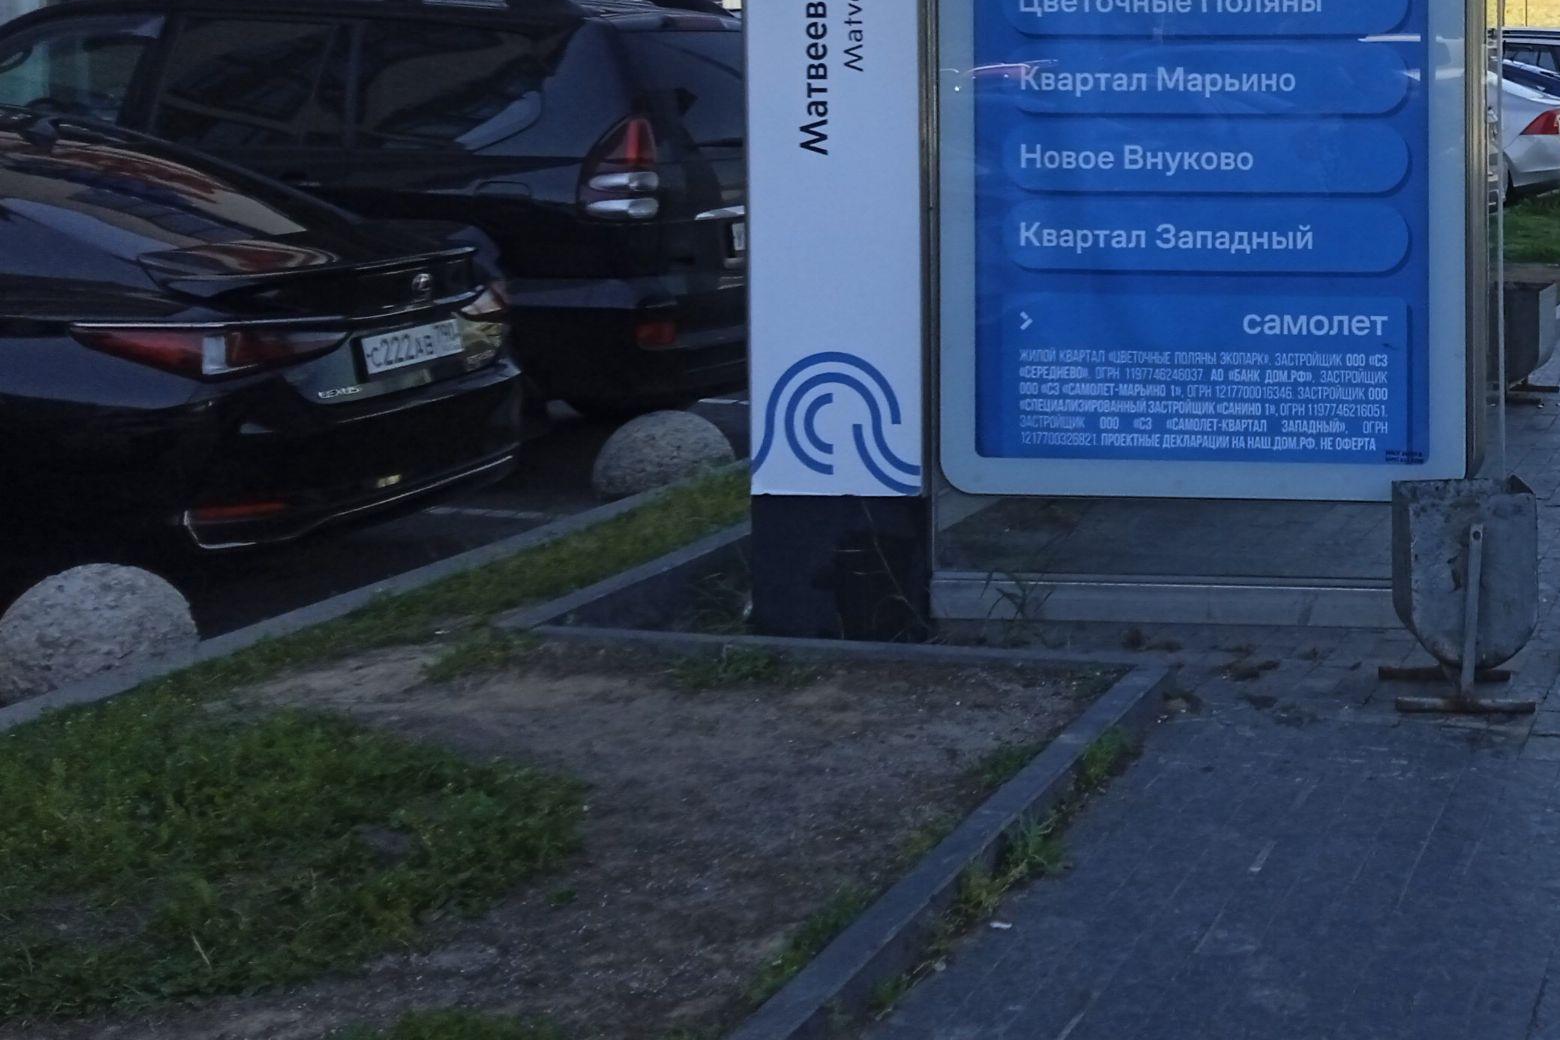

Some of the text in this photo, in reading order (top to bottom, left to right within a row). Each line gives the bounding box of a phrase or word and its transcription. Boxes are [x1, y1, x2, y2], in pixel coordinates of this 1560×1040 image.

[1019, 66, 1297, 96] Квартал Марьино
[1019, 143, 1254, 176] Новое Внуково
[1018, 221, 1314, 255] Квартал Западный
[1242, 312, 1389, 337] самолет
[1059, 349, 1106, 363] КВАРТАЛ
[1275, 351, 1342, 367] ЗАСТРОЙЩИК
[1095, 366, 1120, 380] ОГРН
[1210, 368, 1224, 381] АО
[1320, 368, 1388, 384] ЗАСТРОЙЩИК
[1187, 385, 1212, 398] ОГРН
[1297, 385, 1365, 401] ЗАСТРОЙЩИК
[1148, 399, 1215, 416] ЗАСТРОЙЩИК
[1280, 403, 1305, 416] ОГРН
[1362, 421, 1388, 434] ОГРН
[1101, 433, 1160, 447] ПРОЕКТНЫЕ
[1162, 434, 1230, 449] ДЕКЛАРАЦИИ
[1232, 436, 1245, 449] НА
[1320, 437, 1333, 450] НЕ
[1336, 437, 1376, 451] ОФЕРТА
